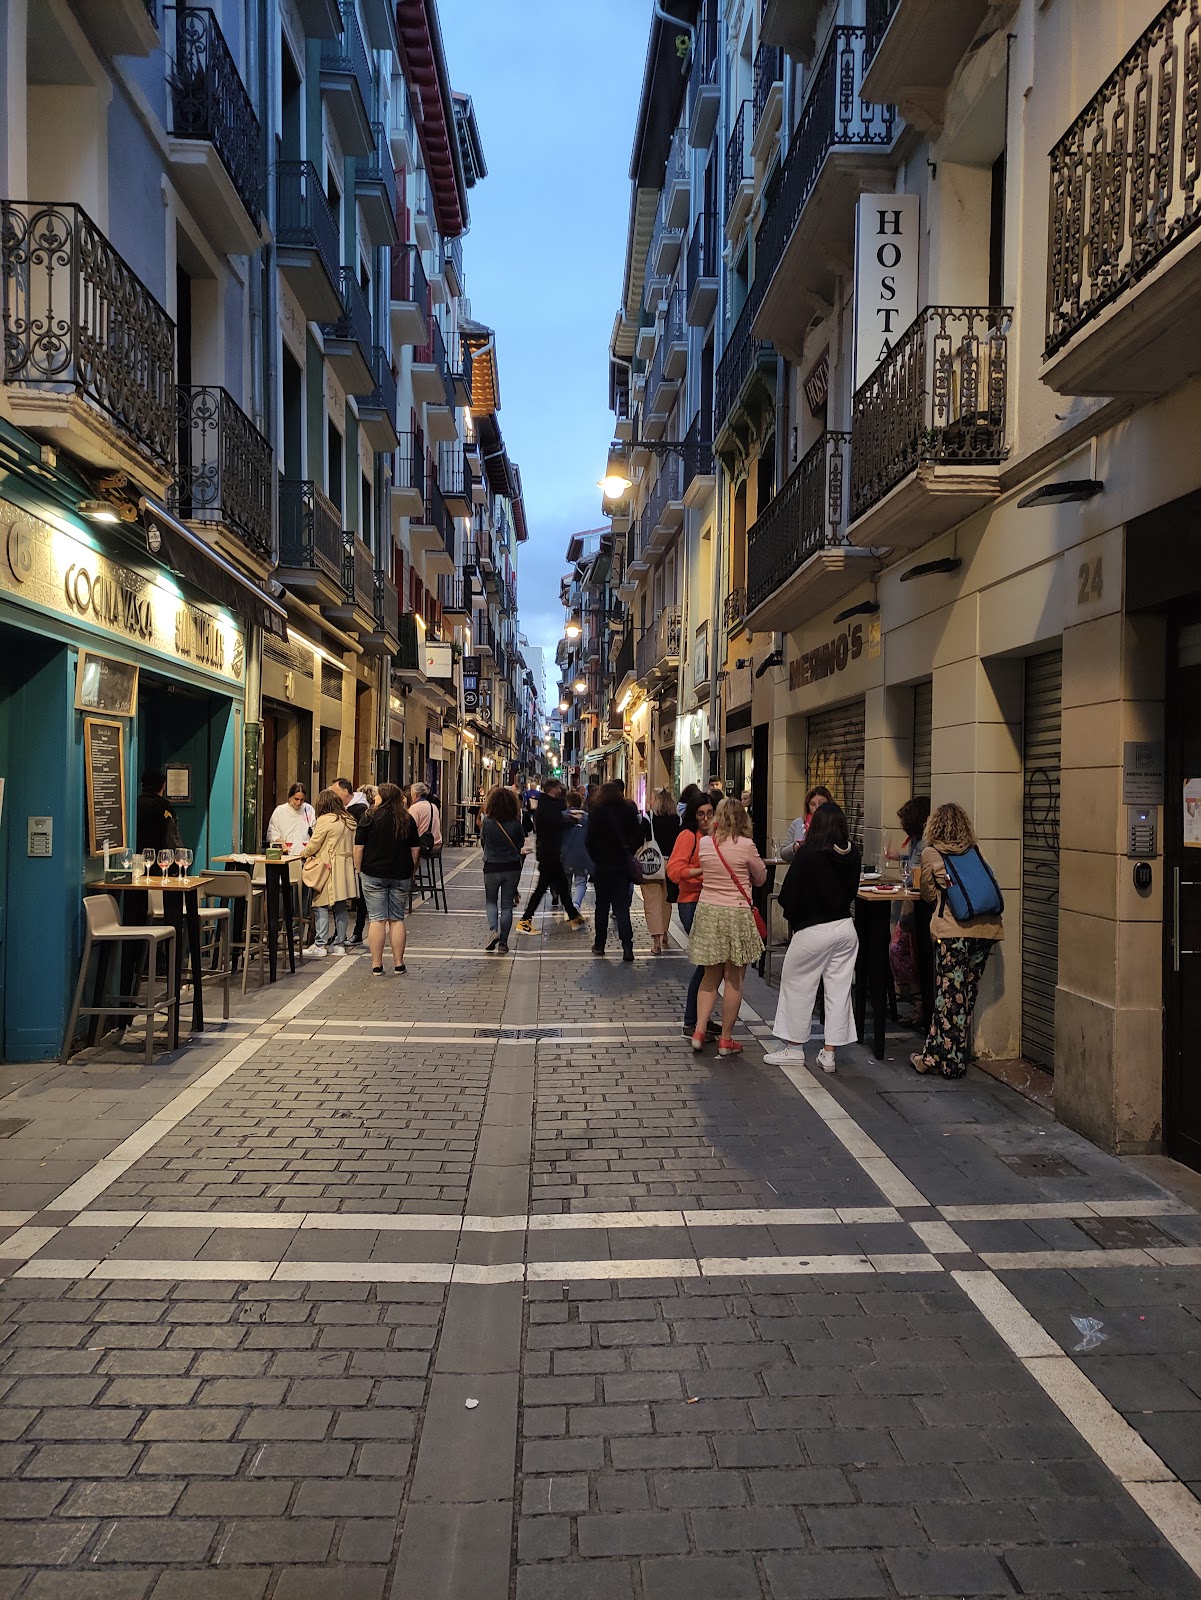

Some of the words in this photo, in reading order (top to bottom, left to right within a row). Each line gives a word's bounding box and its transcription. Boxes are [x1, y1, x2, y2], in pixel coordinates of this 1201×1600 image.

[876, 210, 903, 362] HOSTA
[806, 355, 830, 409] HOSTA
[13, 531, 32, 572] 13
[65, 563, 119, 628] COCINA
[121, 587, 152, 638] VASCA
[1078, 556, 1103, 604] 24
[466, 678, 474, 688] H
[789, 623, 862, 691] MERINO'S
